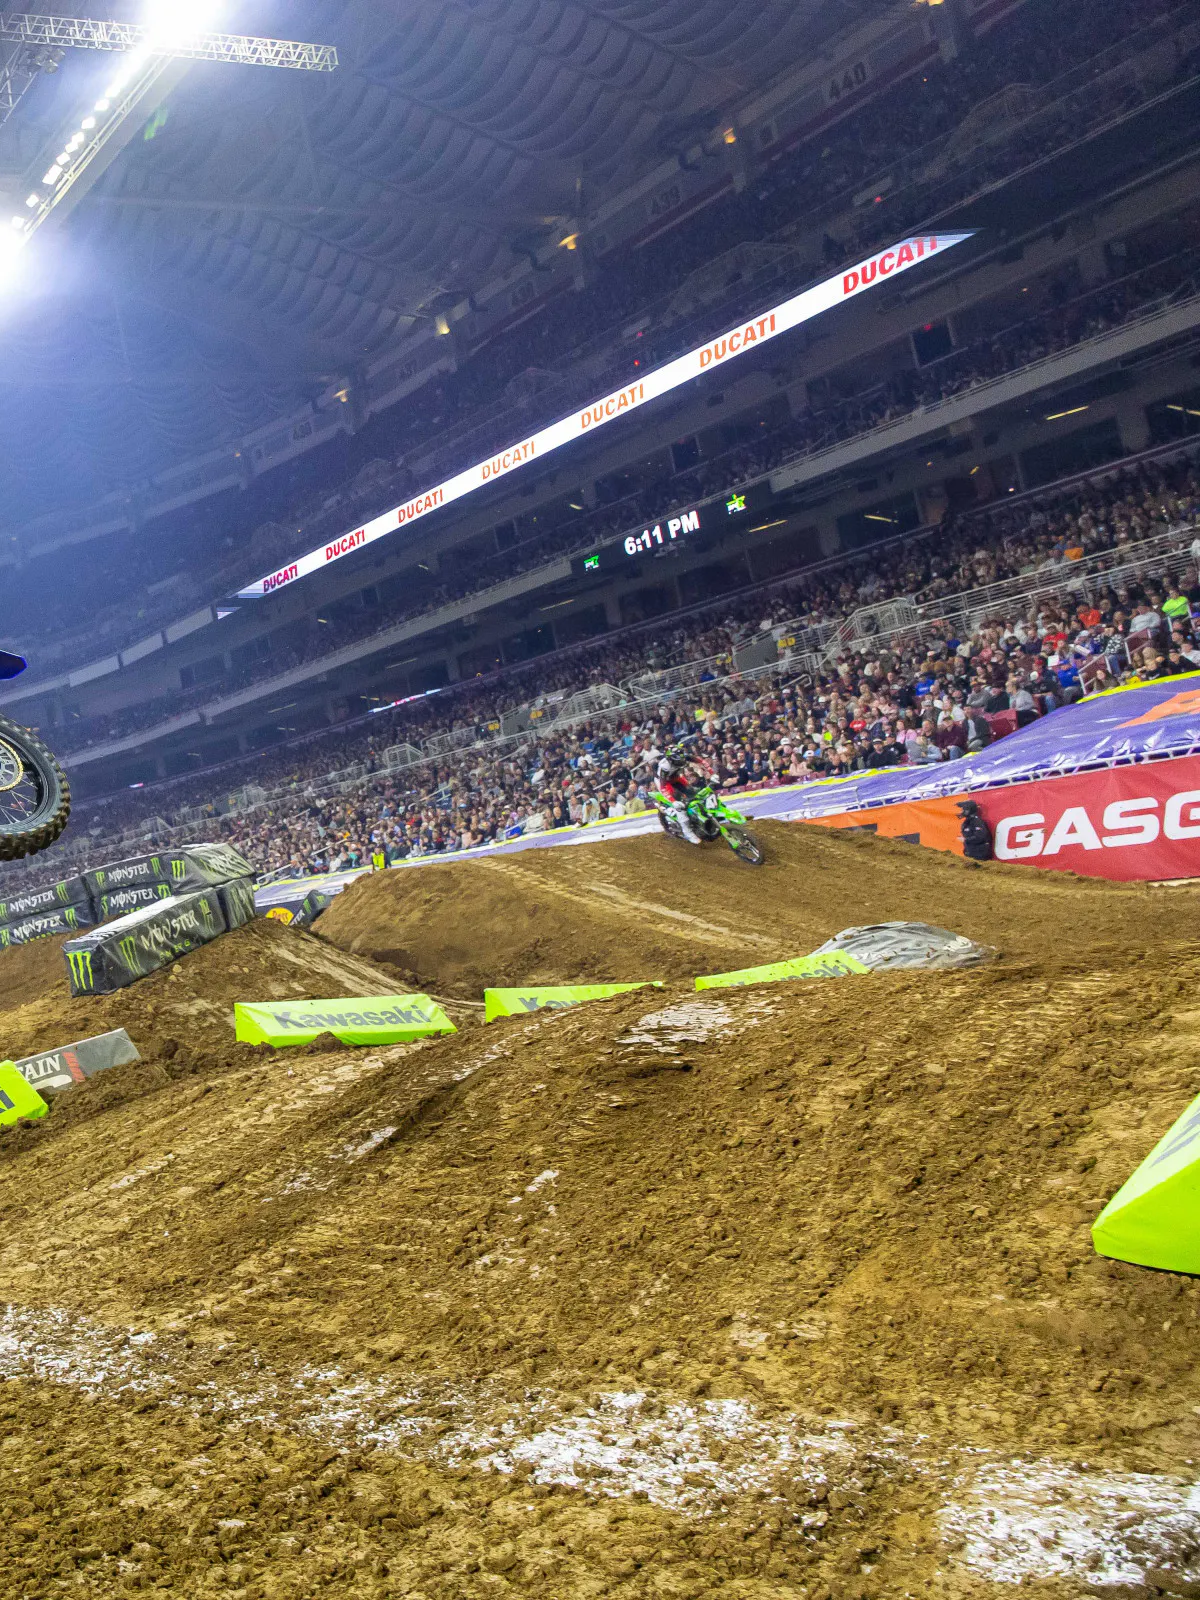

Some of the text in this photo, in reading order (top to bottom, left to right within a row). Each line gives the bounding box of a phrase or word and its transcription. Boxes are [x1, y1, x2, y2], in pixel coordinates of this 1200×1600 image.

[843, 236, 938, 294] DUCATI
[699, 314, 776, 368] DUCATI
[581, 383, 644, 429] DUCATI
[482, 441, 535, 480] DUCATI
[398, 489, 443, 523] DUCATI
[325, 529, 365, 561] DUCATI
[624, 510, 700, 556] 6:11 PM
[263, 564, 298, 593] DUCATI
[271, 1004, 433, 1029] Kawasaki
